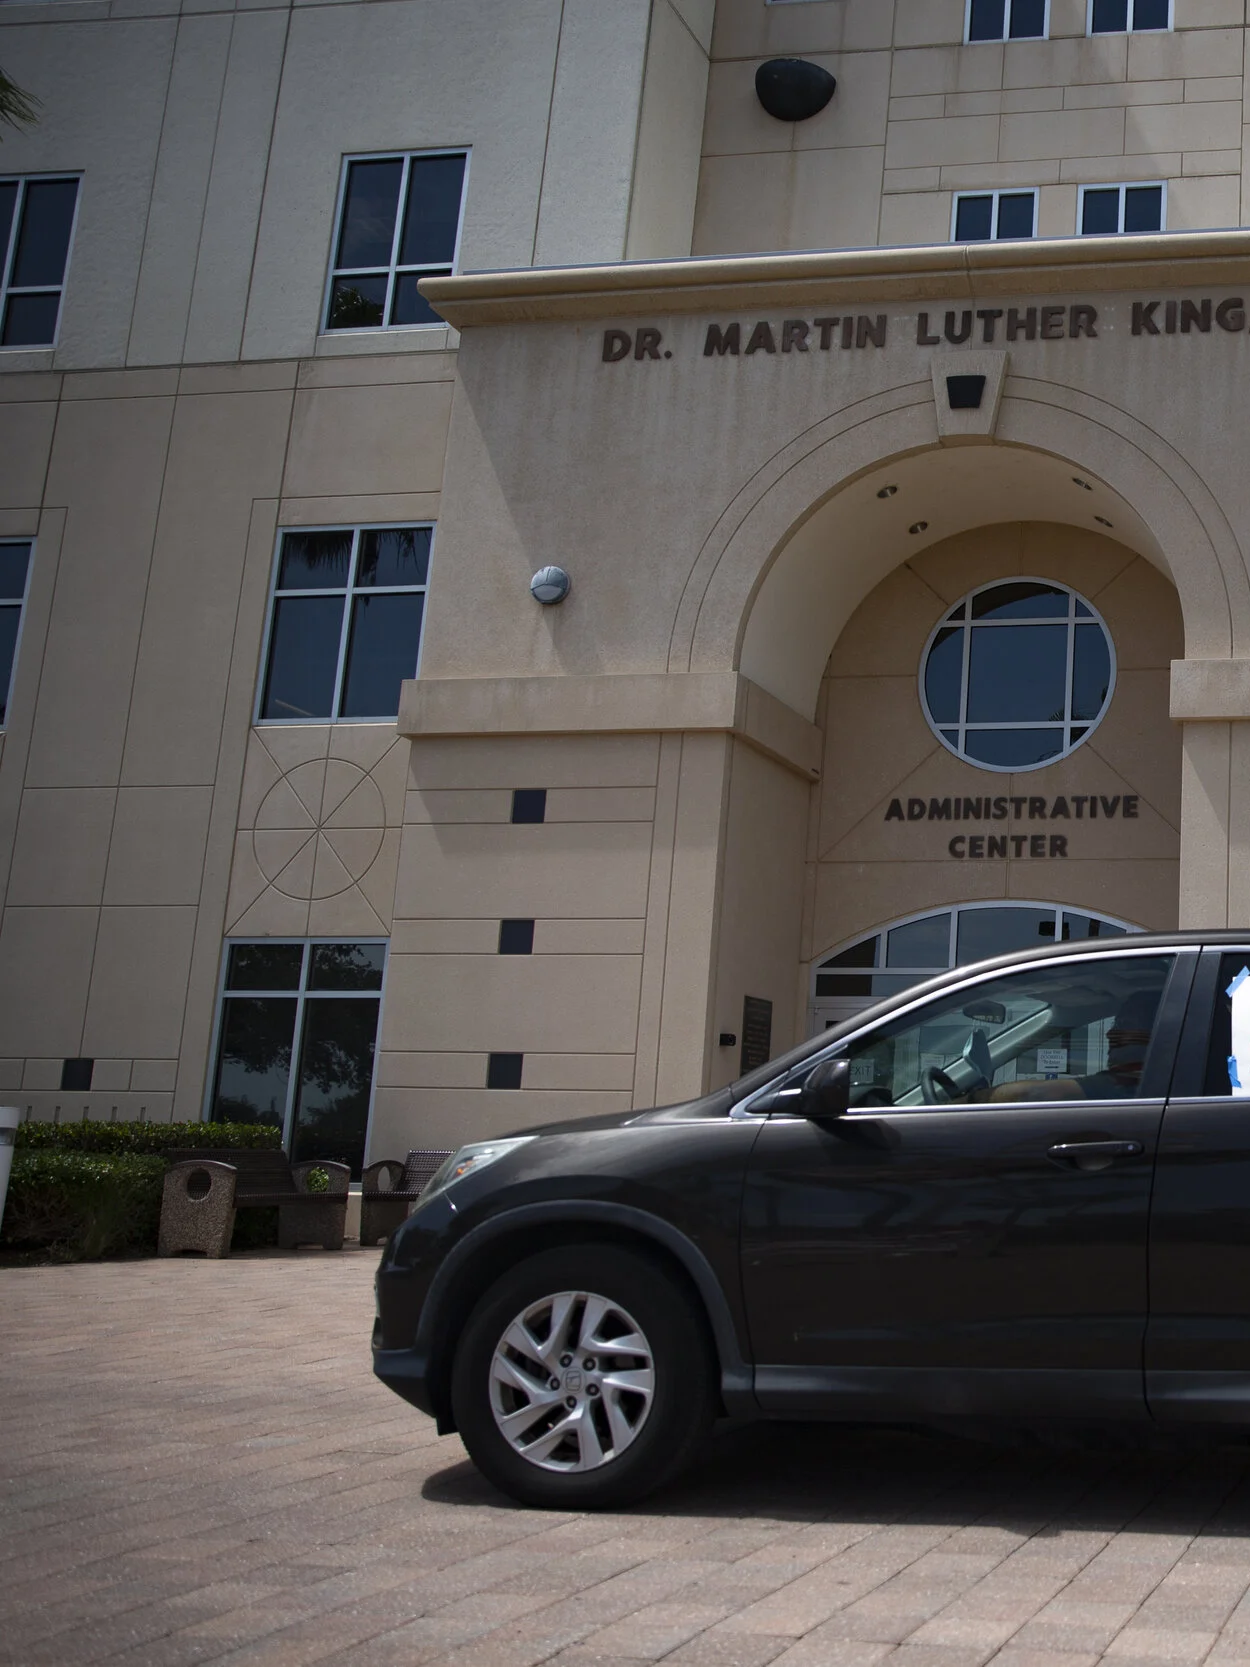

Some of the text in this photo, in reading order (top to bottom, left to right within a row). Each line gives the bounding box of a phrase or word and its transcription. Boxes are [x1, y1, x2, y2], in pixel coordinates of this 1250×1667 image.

[602, 327, 672, 362] DR.
[703, 314, 887, 357] MARTIN
[917, 304, 1098, 346] LUTHER
[884, 795, 1139, 821] ADMINISTRATIVE
[948, 835, 1068, 859] CENTER
